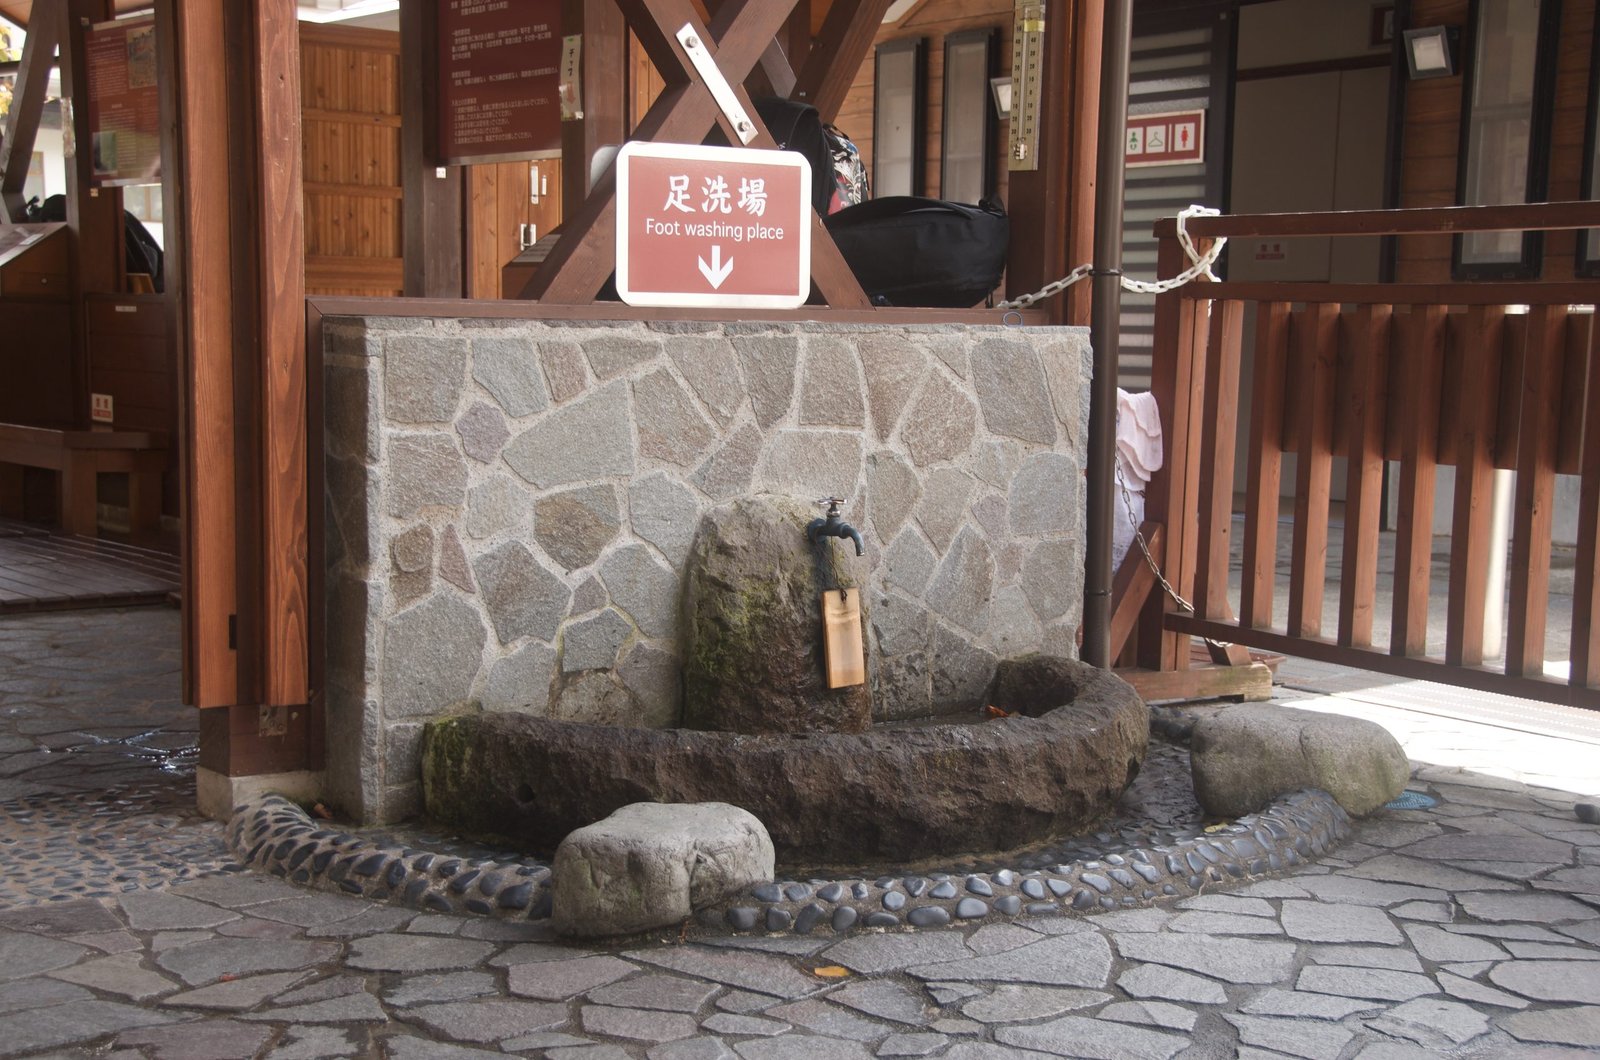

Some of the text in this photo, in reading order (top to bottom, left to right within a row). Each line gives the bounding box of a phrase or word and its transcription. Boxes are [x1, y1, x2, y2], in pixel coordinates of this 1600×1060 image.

[663, 174, 768, 217] 足洗場
[646, 218, 784, 242] Foot washing place
